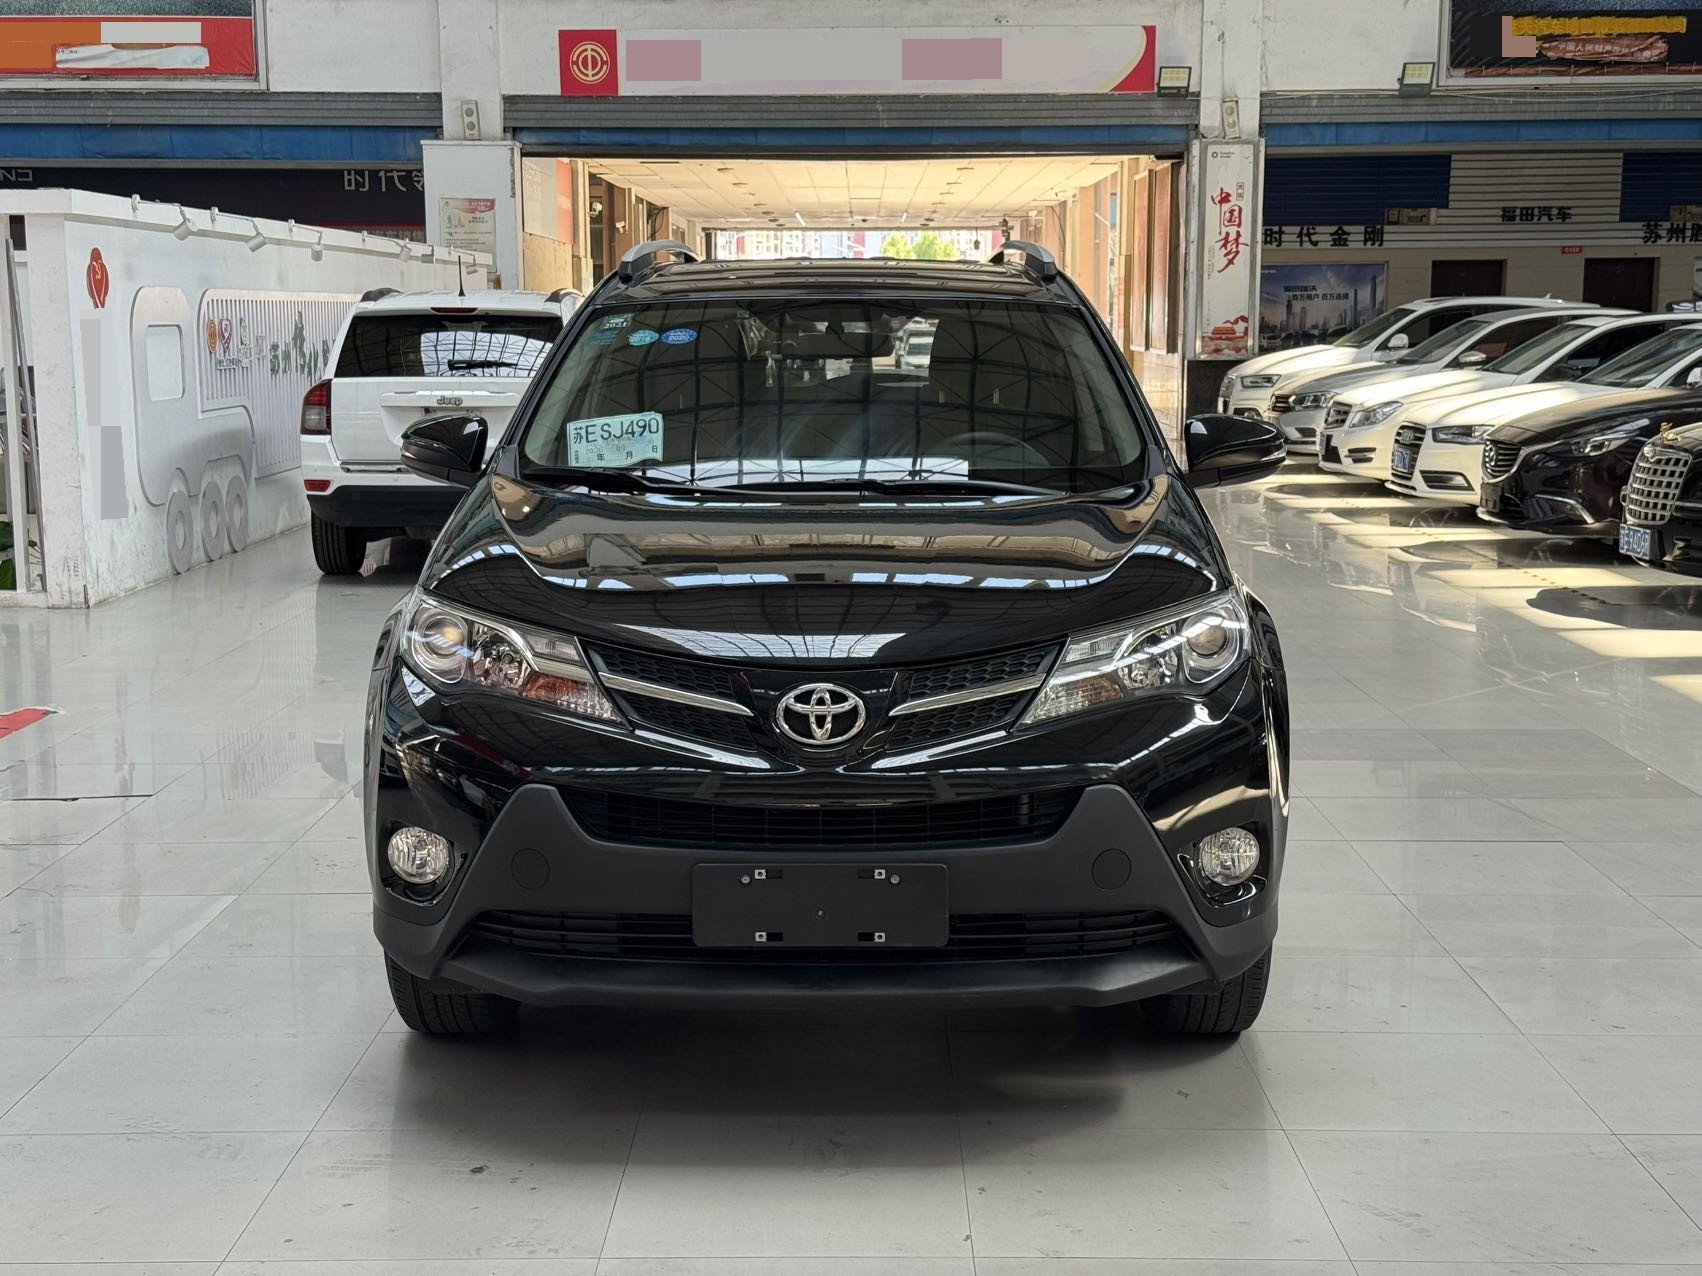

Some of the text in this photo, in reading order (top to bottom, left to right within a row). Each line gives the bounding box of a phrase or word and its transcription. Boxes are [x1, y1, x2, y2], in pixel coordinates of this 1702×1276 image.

[1501, 206, 1573, 223] 福田汽车
[1211, 186, 1249, 273] 中国梦
[1264, 225, 1385, 248] 时代金刚
[436, 395, 463, 406] Jeep
[625, 450, 633, 460] 月
[651, 444, 659, 454] 日
